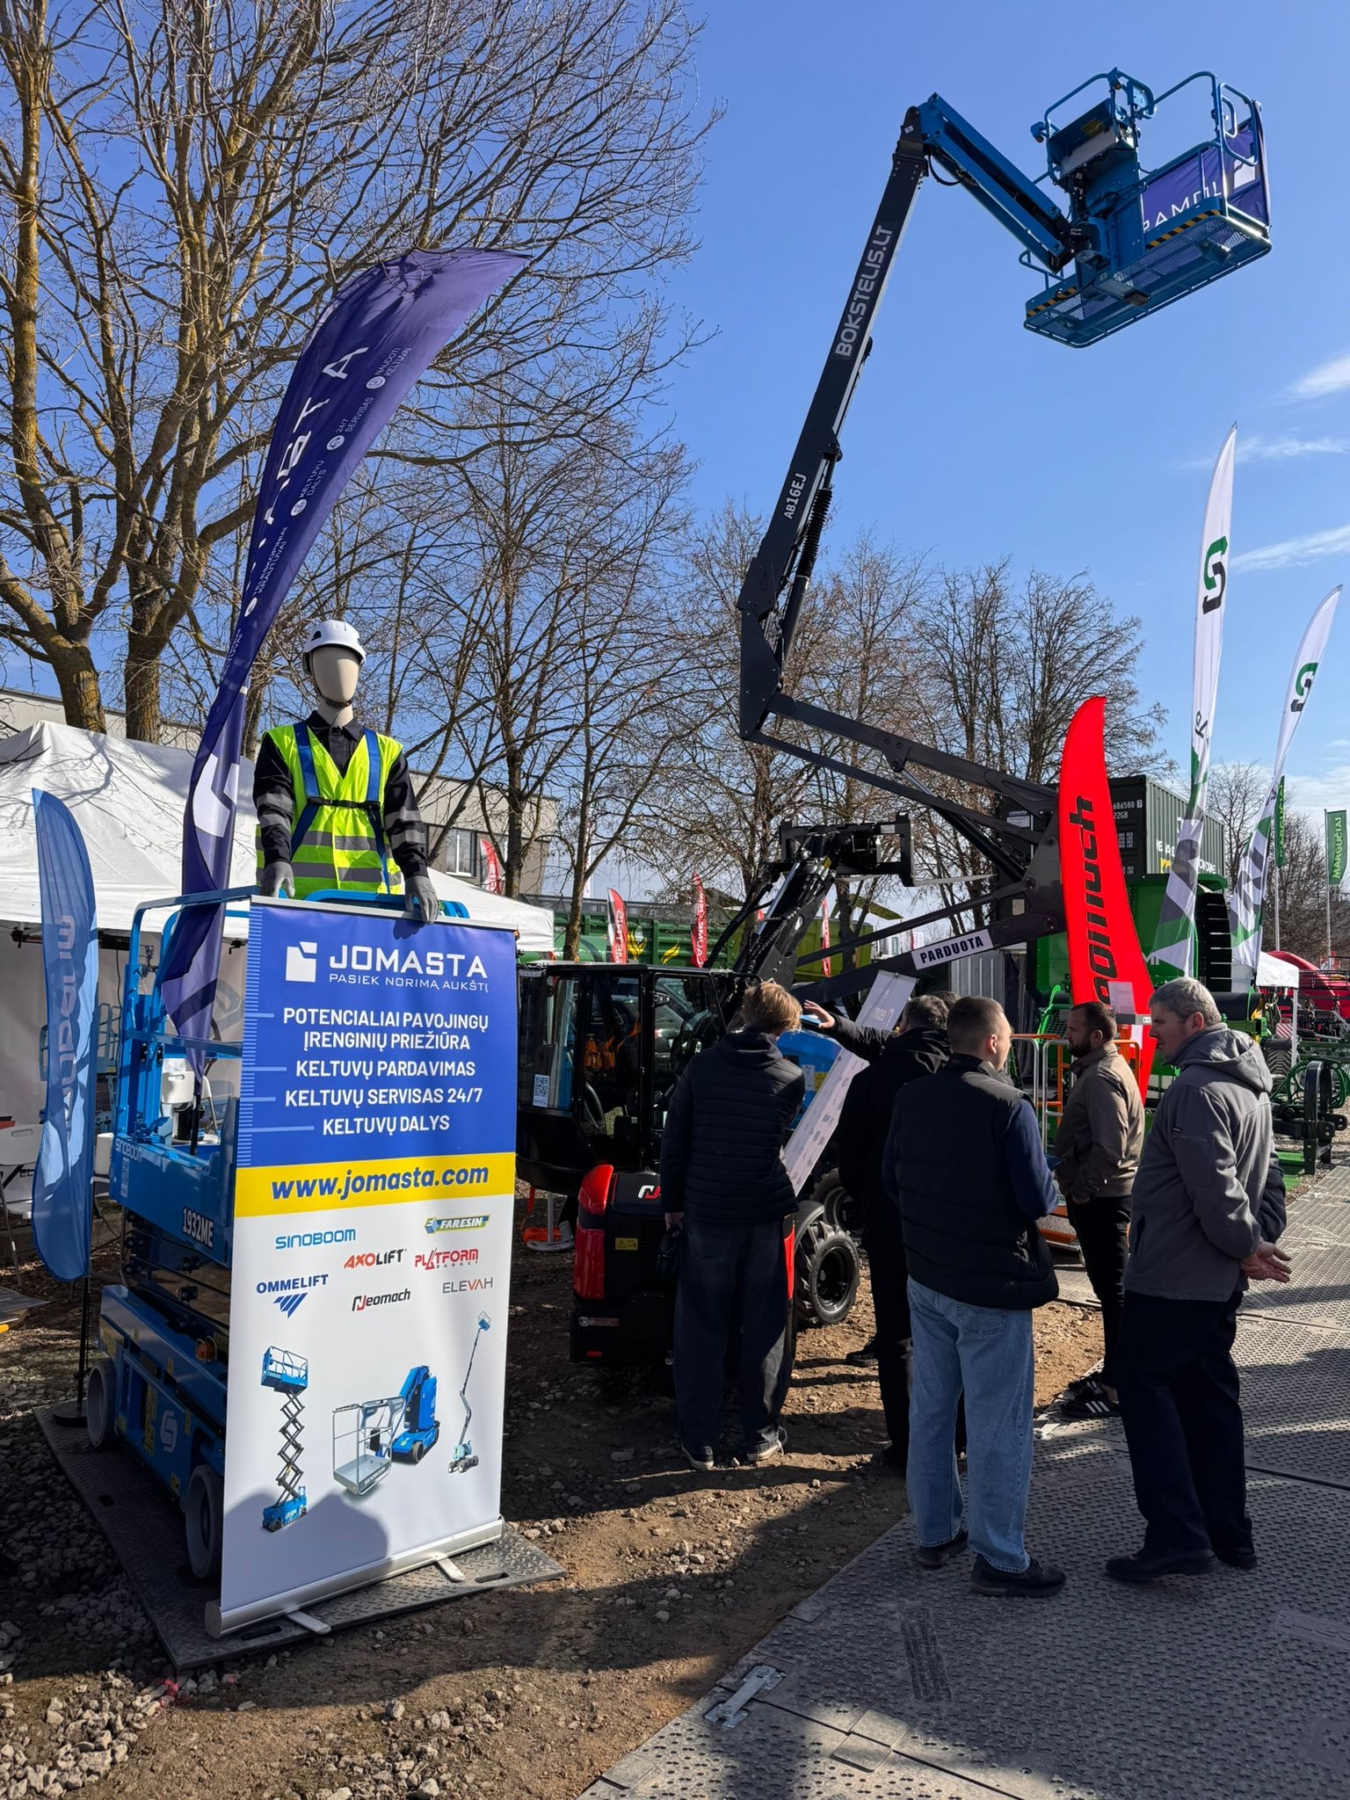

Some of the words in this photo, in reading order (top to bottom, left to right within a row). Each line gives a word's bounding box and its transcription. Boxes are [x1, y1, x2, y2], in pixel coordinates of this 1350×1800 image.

[835, 225, 894, 358] BOKSTELIS.LT
[344, 396, 374, 432] SERVISAS
[307, 469, 327, 495] DALYS
[783, 472, 807, 519] AB16EJ
[329, 944, 488, 979] JOMASTA
[920, 936, 984, 964] PARDUOTA
[329, 973, 379, 985] PASIEK
[385, 976, 440, 990] NORIMĄ
[442, 979, 489, 993] AUKŠTĮ
[283, 1008, 399, 1028] POTENCIALIAI
[403, 1012, 489, 1033] PAVOJINGŲ
[303, 1031, 387, 1052] ĮRENGINIŲ
[391, 1031, 470, 1050] PRIEŽIŪRA
[296, 1060, 373, 1080] KELTUVŲ
[377, 1061, 475, 1077] PARDAVIMAS
[285, 1090, 363, 1109] KELTUVŲ
[367, 1088, 444, 1104] SERVISAS
[447, 1087, 483, 1104] 24/7
[323, 1117, 397, 1136] KELTUVŲ
[400, 1115, 450, 1132] DALYS
[271, 1167, 489, 1200] www.jomasta.com
[183, 1208, 214, 1247] 1932ME
[439, 1217, 483, 1230] FARESIN
[343, 1249, 404, 1269] AXOLIFT
[415, 1247, 479, 1271] PLATFORM
[256, 1274, 328, 1294] OMMELIFT
[442, 1277, 493, 1294] ELEVAH
[352, 1288, 411, 1312] Neomach
